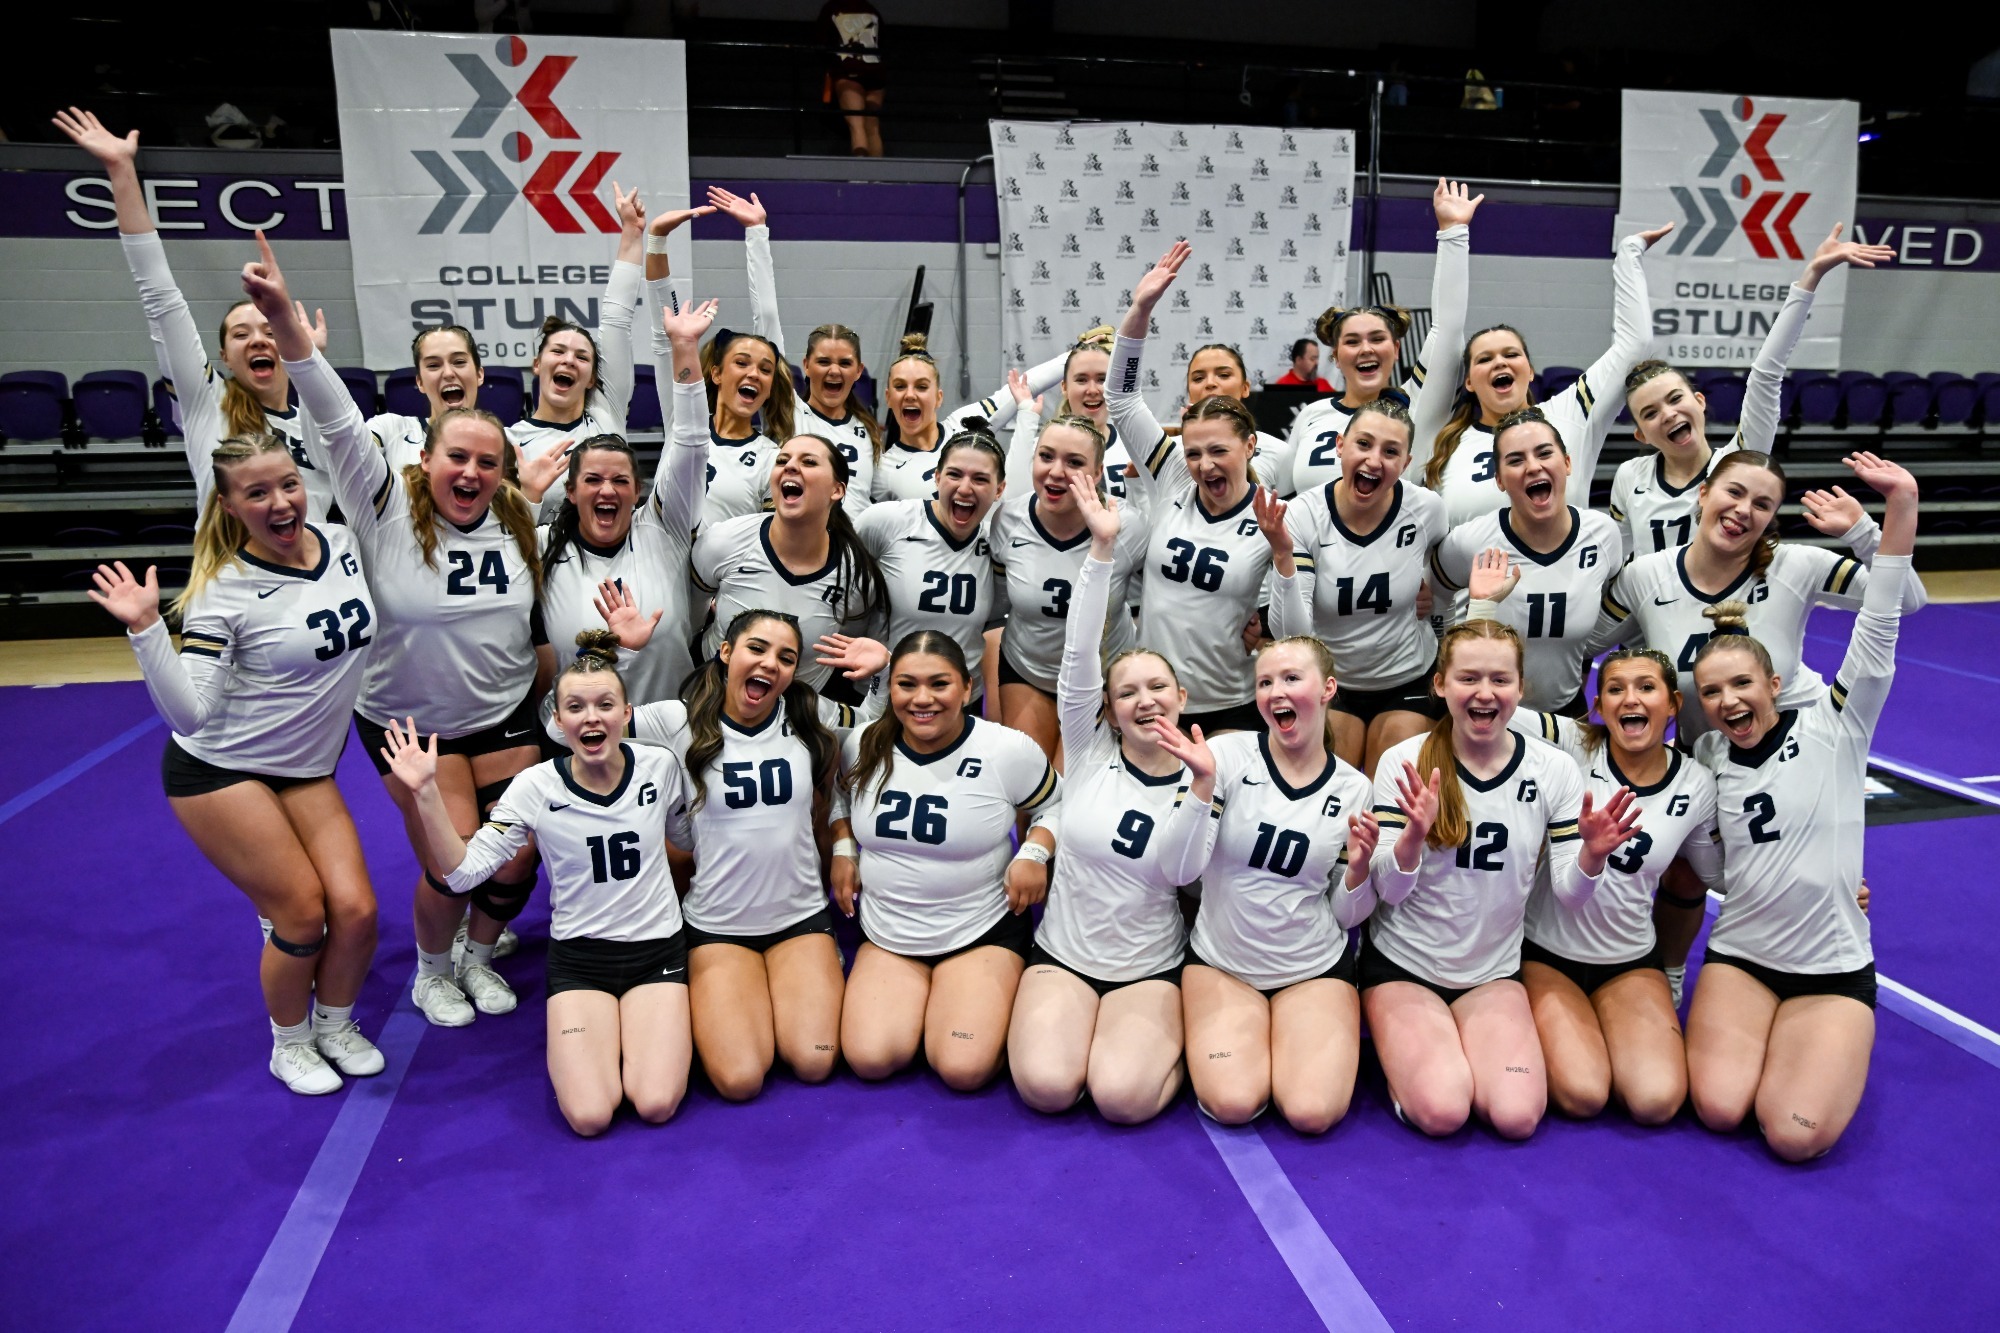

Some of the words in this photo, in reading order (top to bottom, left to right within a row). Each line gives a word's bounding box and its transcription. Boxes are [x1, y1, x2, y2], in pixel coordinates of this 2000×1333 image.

[65, 178, 345, 231] SECT
[440, 265, 609, 285] COLLEGE
[1675, 282, 1790, 301] COLLEGE
[411, 297, 642, 331] STUN
[1652, 308, 1810, 337] STUN
[1122, 357, 1139, 393] BRUINS
[1668, 345, 1760, 360] ASSOCIAT
[446, 550, 510, 596] 24
[1161, 537, 1230, 593] 36
[918, 570, 977, 615] 20
[1336, 572, 1392, 616] 14
[1526, 592, 1567, 638] 11
[306, 598, 373, 662] 32
[722, 757, 793, 810] 50
[875, 789, 949, 846] 26
[1111, 809, 1155, 859] 9
[1743, 792, 1781, 844] 2
[586, 831, 641, 884] 16
[1248, 822, 1311, 878] 10
[1455, 821, 1509, 872] 12
